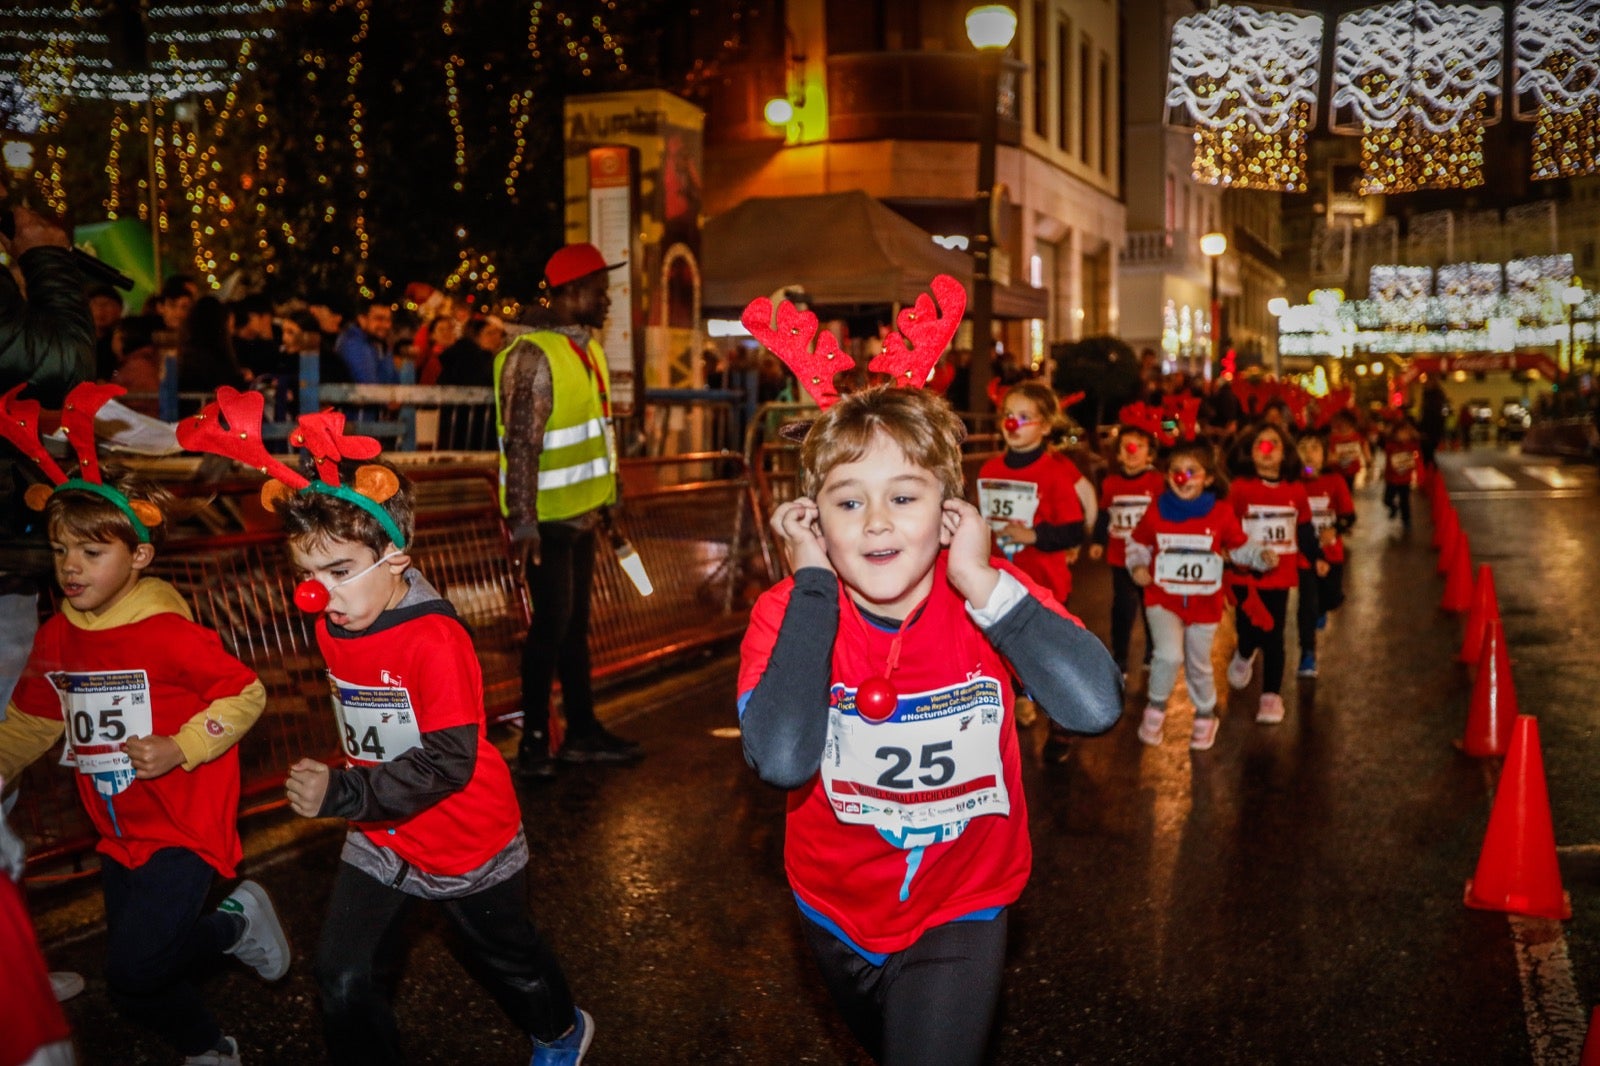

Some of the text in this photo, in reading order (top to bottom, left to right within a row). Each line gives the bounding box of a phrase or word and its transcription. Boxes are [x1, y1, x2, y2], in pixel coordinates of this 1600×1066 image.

[992, 499, 1014, 516] 35
[1176, 563, 1203, 580] 40
[900, 695, 1000, 722] #NocturnaGranada2022
[875, 740, 956, 790] 25
